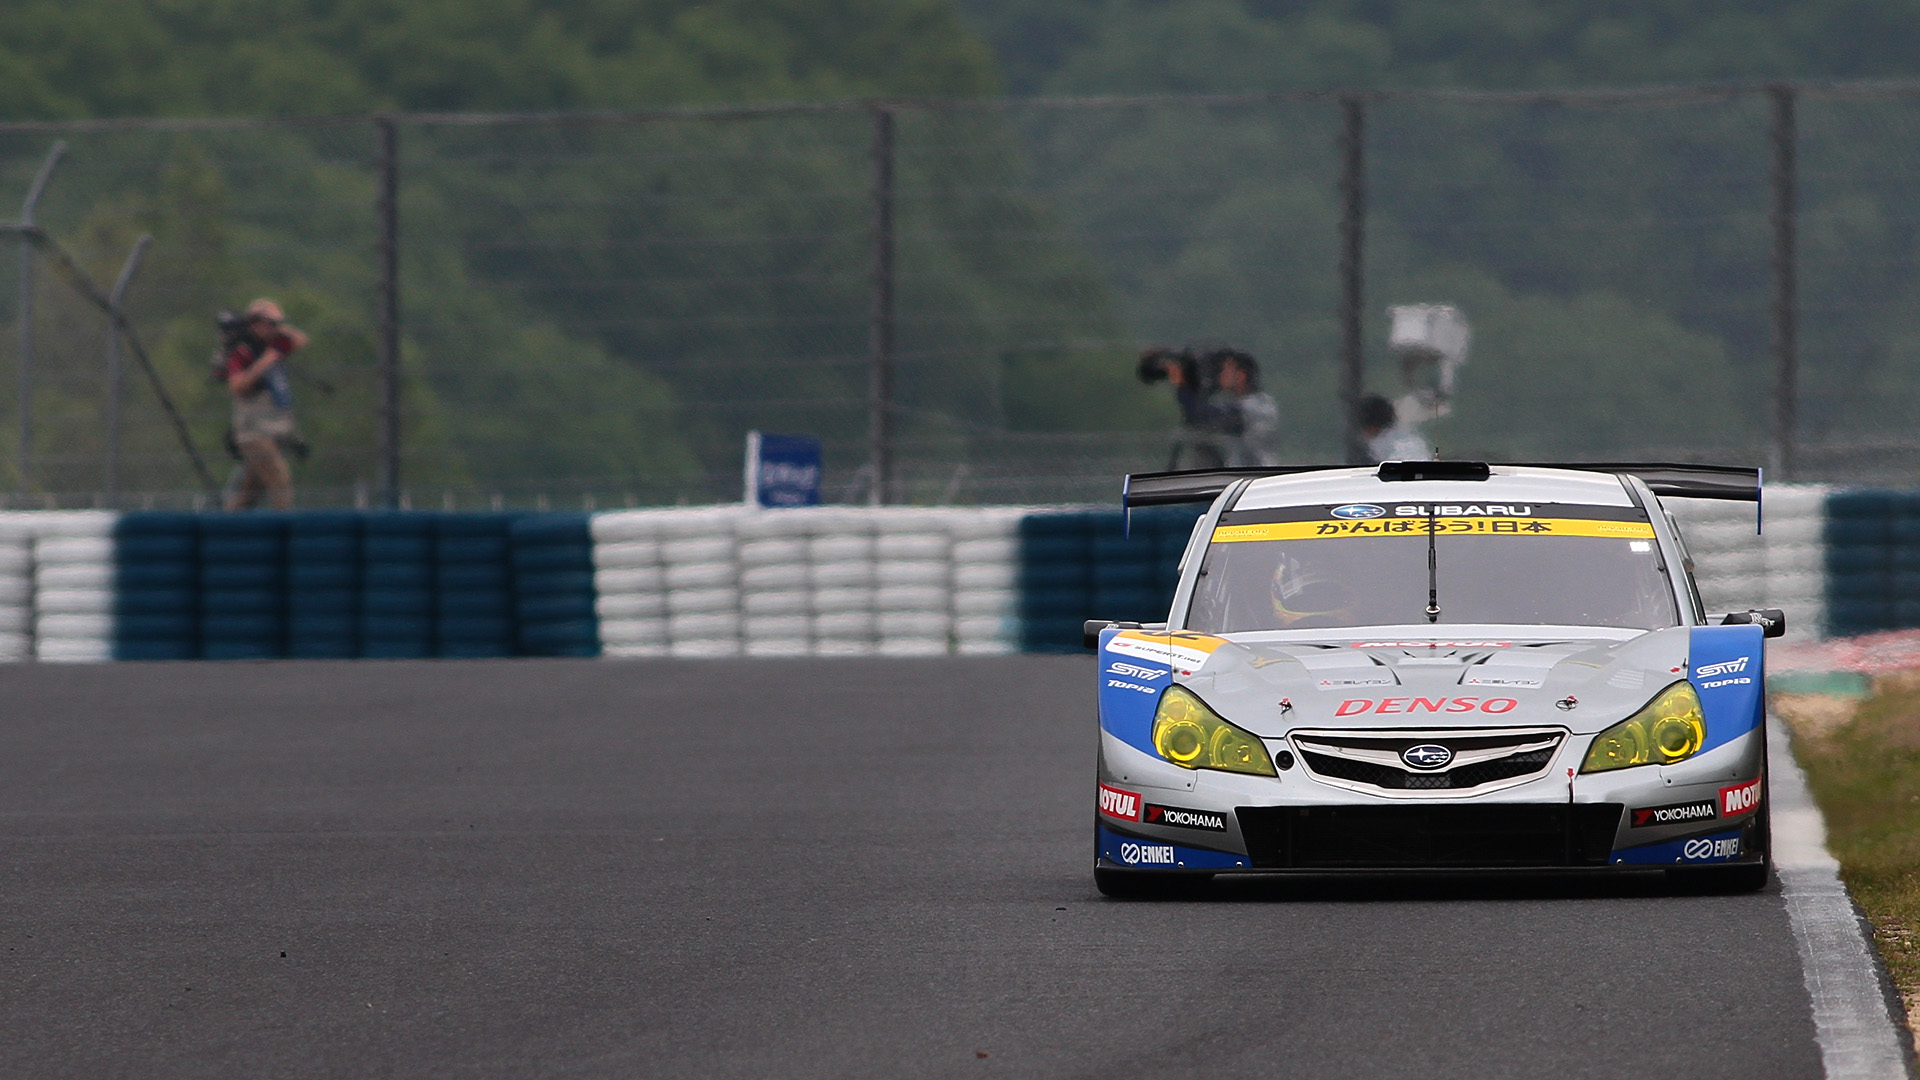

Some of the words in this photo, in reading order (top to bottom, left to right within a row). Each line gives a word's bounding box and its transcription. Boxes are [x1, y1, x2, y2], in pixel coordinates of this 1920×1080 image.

[1395, 505, 1531, 516] SUBARU
[1334, 697, 1518, 717] DENSO
[1164, 810, 1225, 829] YOKOHAMA
[1654, 804, 1714, 822] YOKOHAMA
[1141, 846, 1175, 864] ENKEI
[1714, 838, 1740, 857] ENKEI
